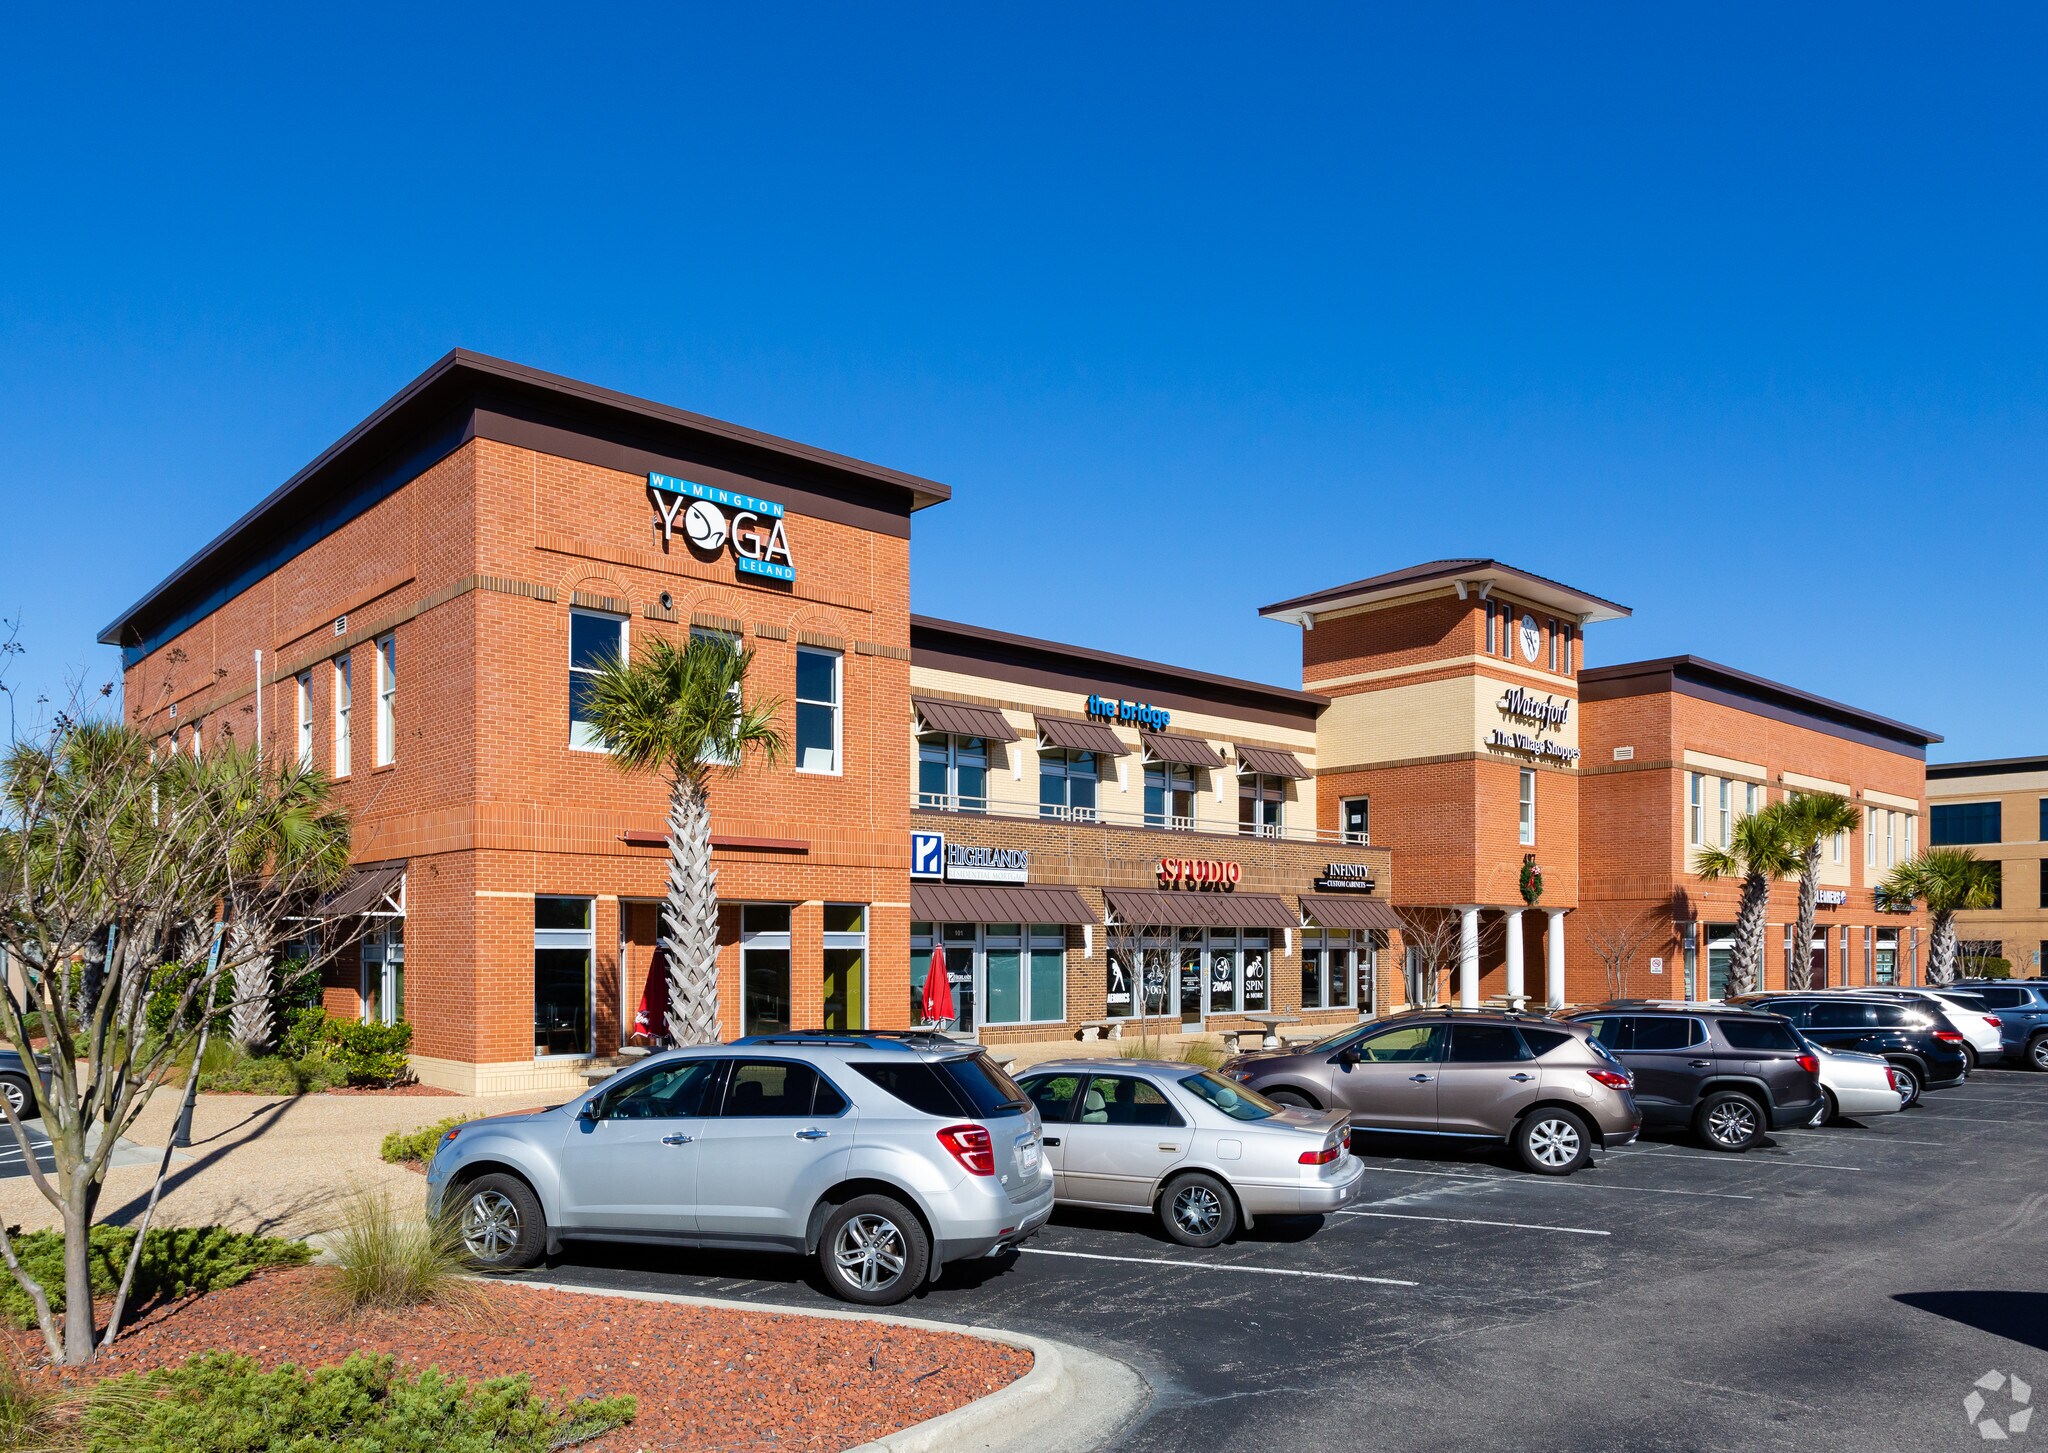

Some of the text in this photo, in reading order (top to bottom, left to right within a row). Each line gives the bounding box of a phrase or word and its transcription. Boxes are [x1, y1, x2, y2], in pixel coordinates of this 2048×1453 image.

[652, 474, 783, 516] WILMINGTON
[653, 489, 793, 567] YOGA
[742, 559, 792, 579] LELAND
[1089, 694, 1170, 729] the bridge
[1508, 688, 1570, 732] Waterford
[1495, 730, 1581, 761] The Village Shoppes
[947, 844, 1029, 869] HIGHLANDS
[948, 870, 1027, 881] RESIDENTIAL MORTGAGE
[1165, 857, 1243, 884] STUDIO
[1330, 863, 1369, 877] INFINITY
[1327, 880, 1366, 888] CUSTOM CABINETS
[1814, 889, 1841, 904] LEANERS
[1212, 981, 1233, 992] ZUMBA
[1245, 980, 1264, 991] SPIN
